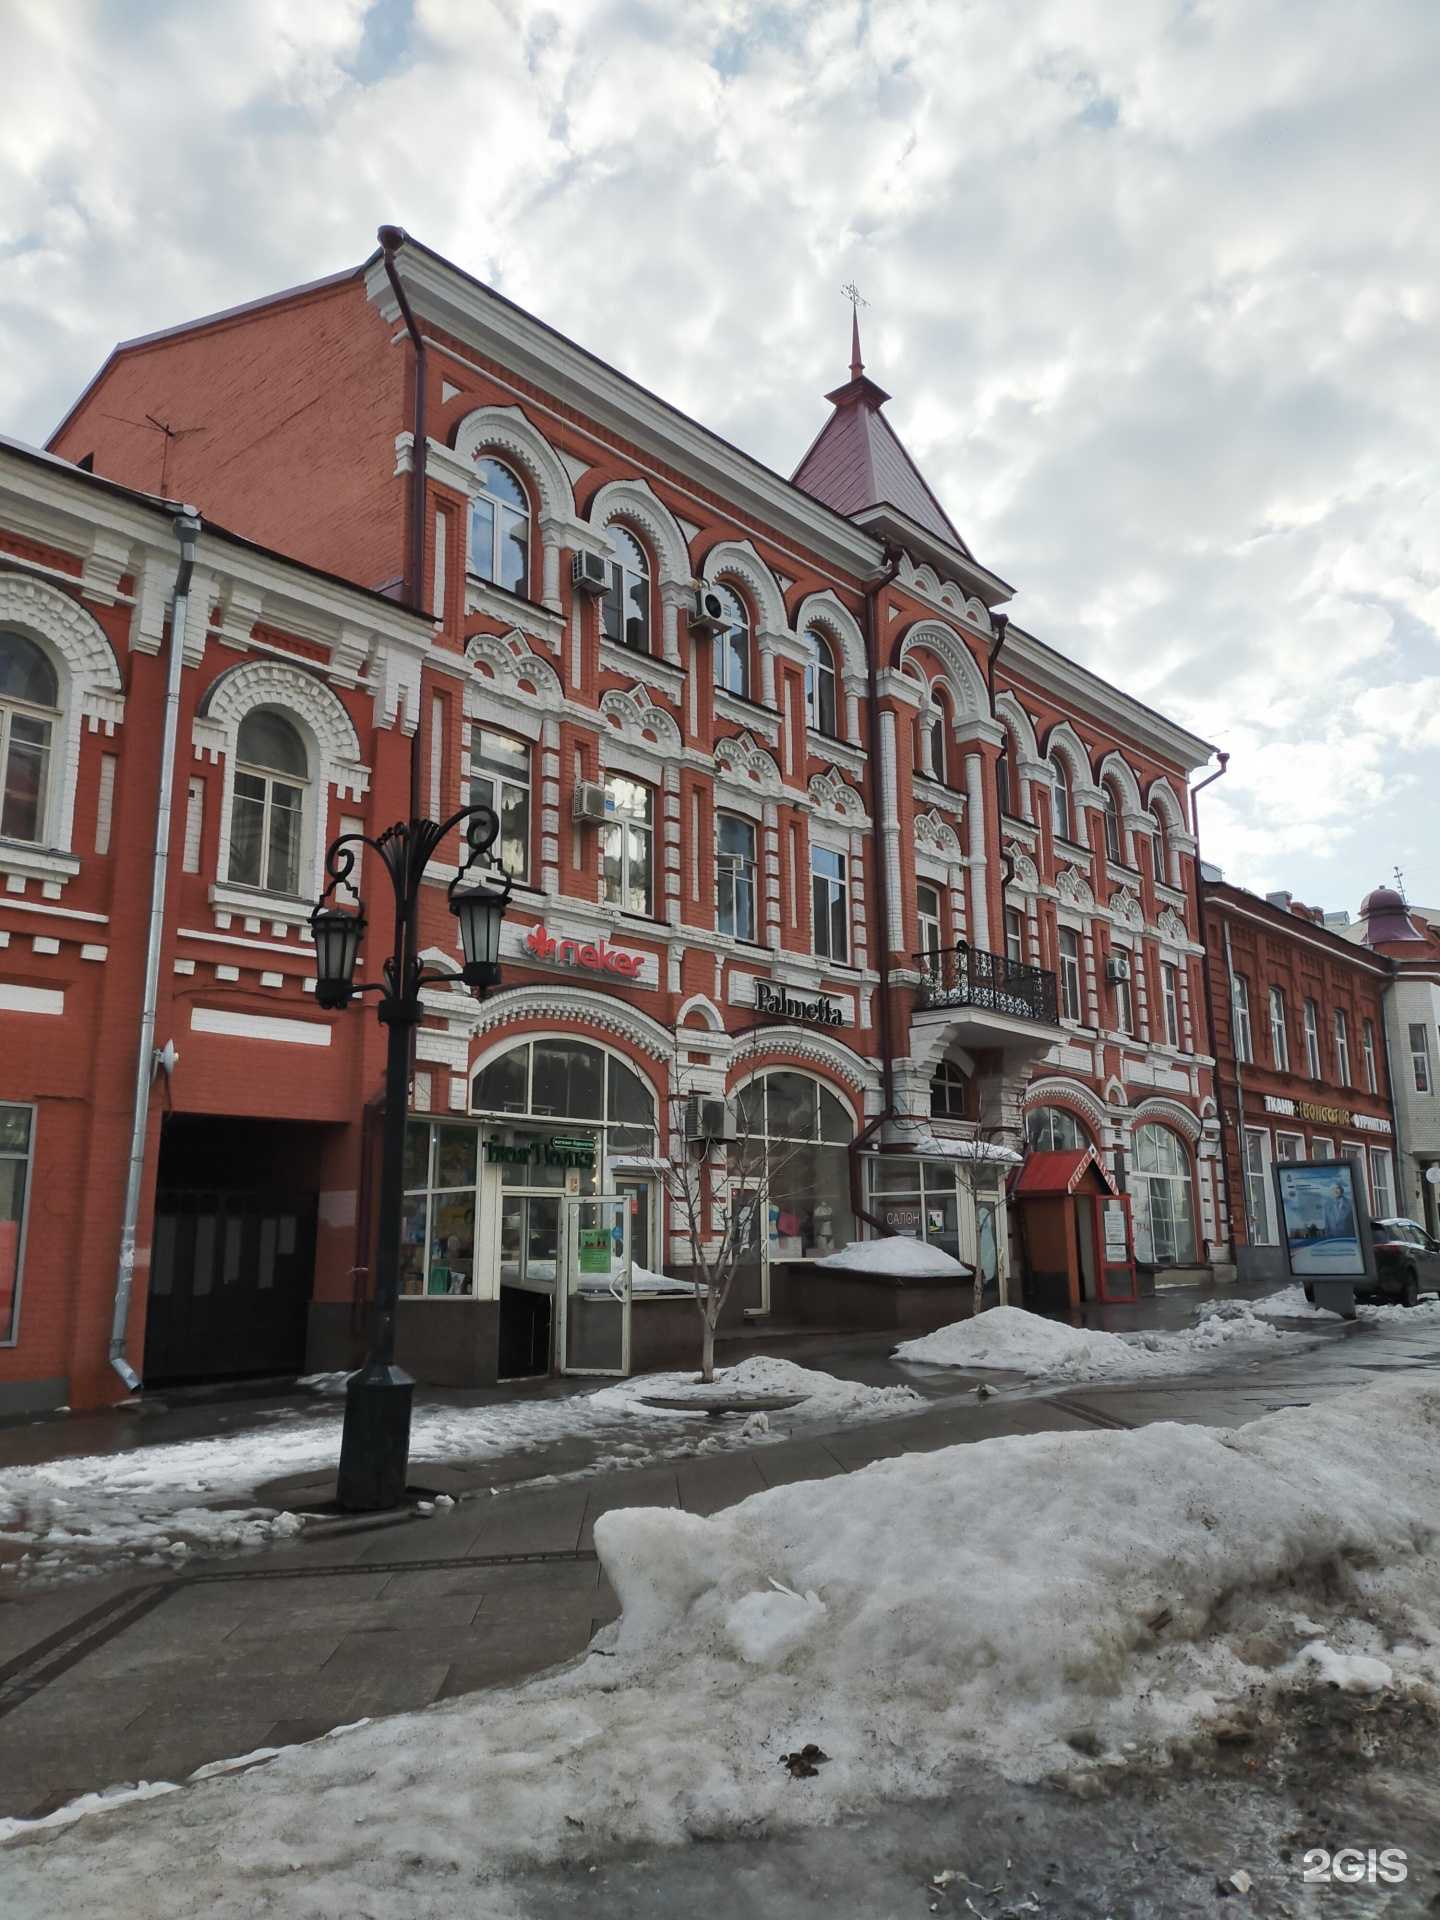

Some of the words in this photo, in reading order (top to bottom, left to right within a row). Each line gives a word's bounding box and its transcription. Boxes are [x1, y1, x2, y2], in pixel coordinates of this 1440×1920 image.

[754, 981, 845, 1026] Palmetta
[1264, 1096, 1294, 1117] ТКАНИ
[887, 1210, 920, 1225] САЛОН
